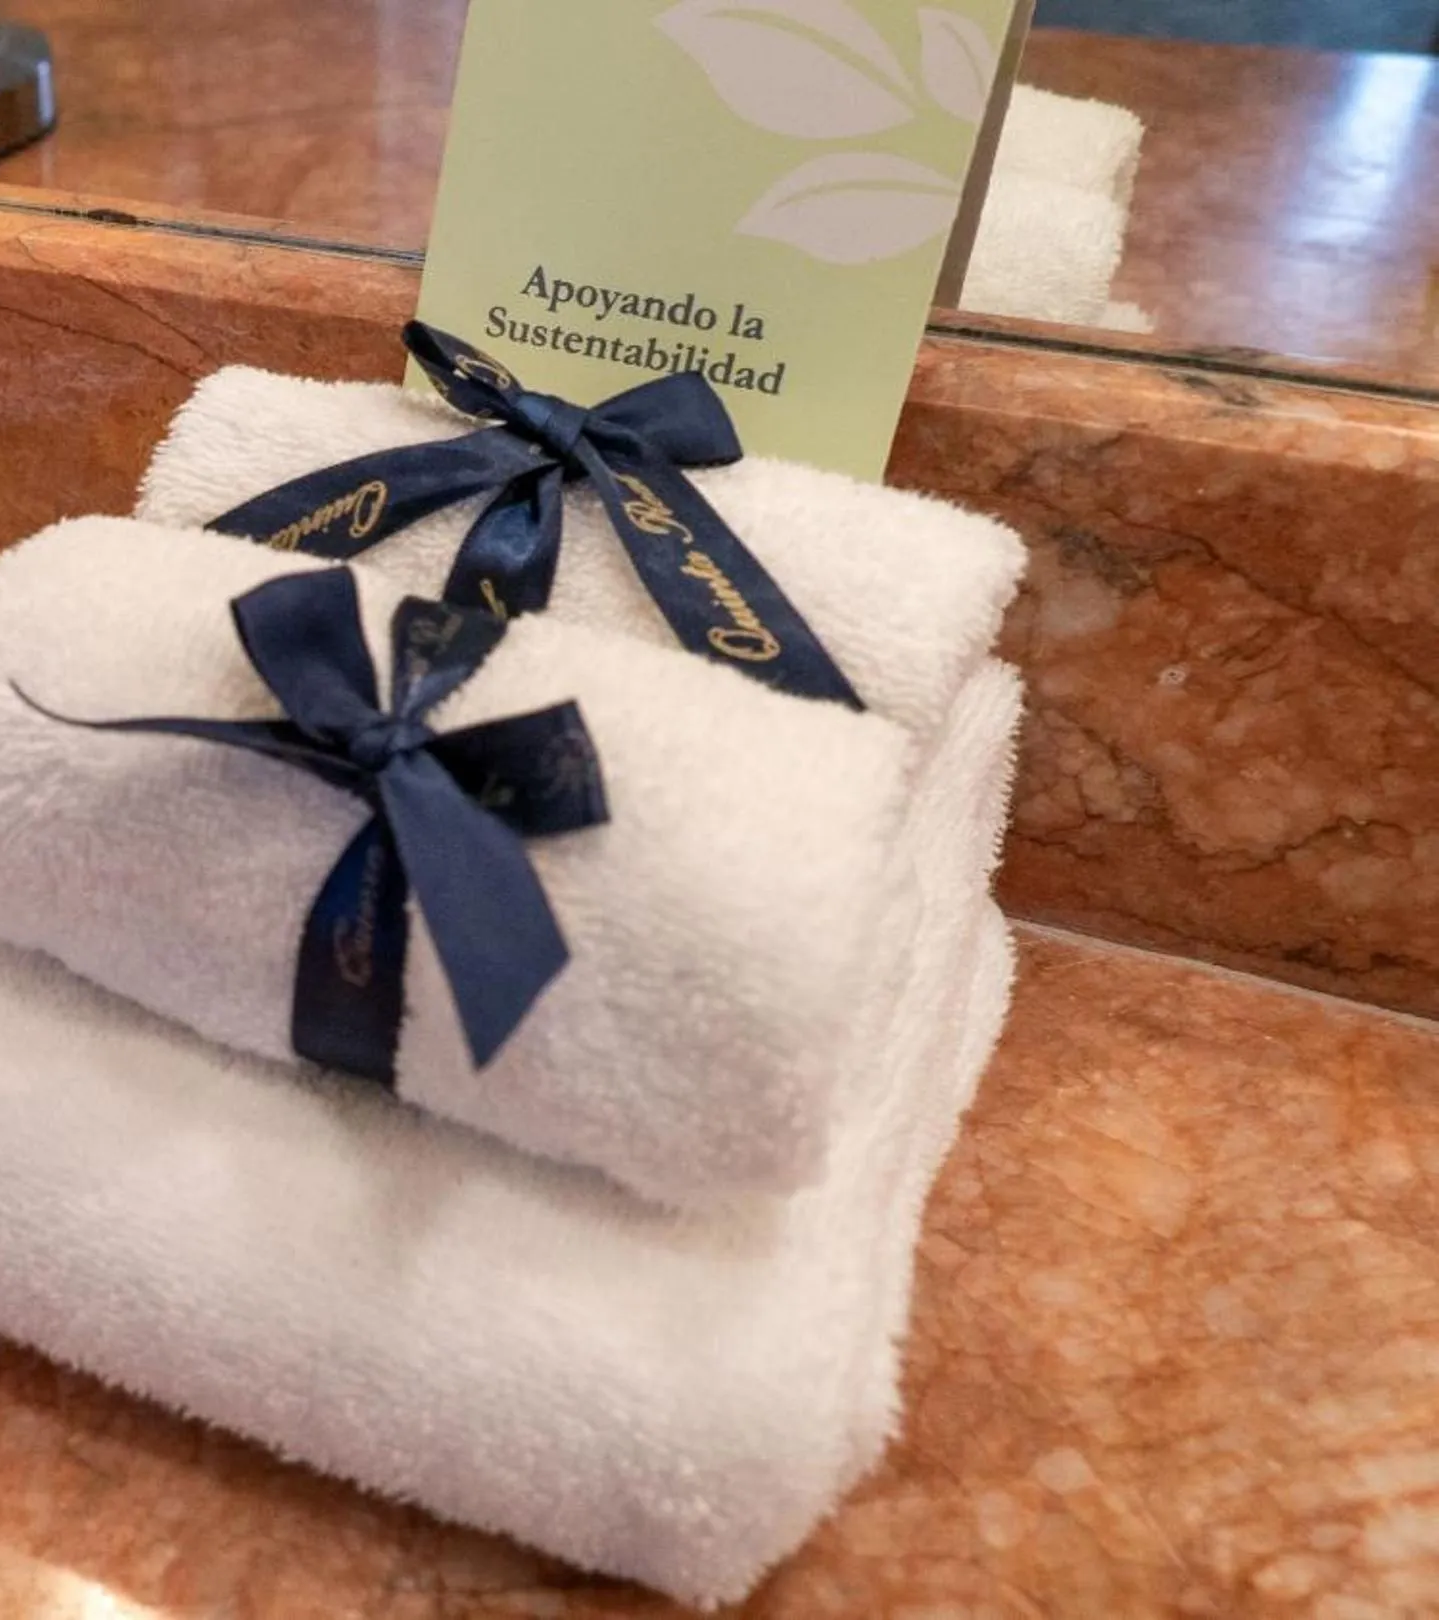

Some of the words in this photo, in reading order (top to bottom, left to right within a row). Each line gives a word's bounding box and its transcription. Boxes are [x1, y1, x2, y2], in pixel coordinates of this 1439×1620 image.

[520, 264, 717, 331] Apoyando
[727, 303, 765, 341] la
[485, 306, 787, 396] Sustentabilidad
[678, 550, 781, 661] Quinta
